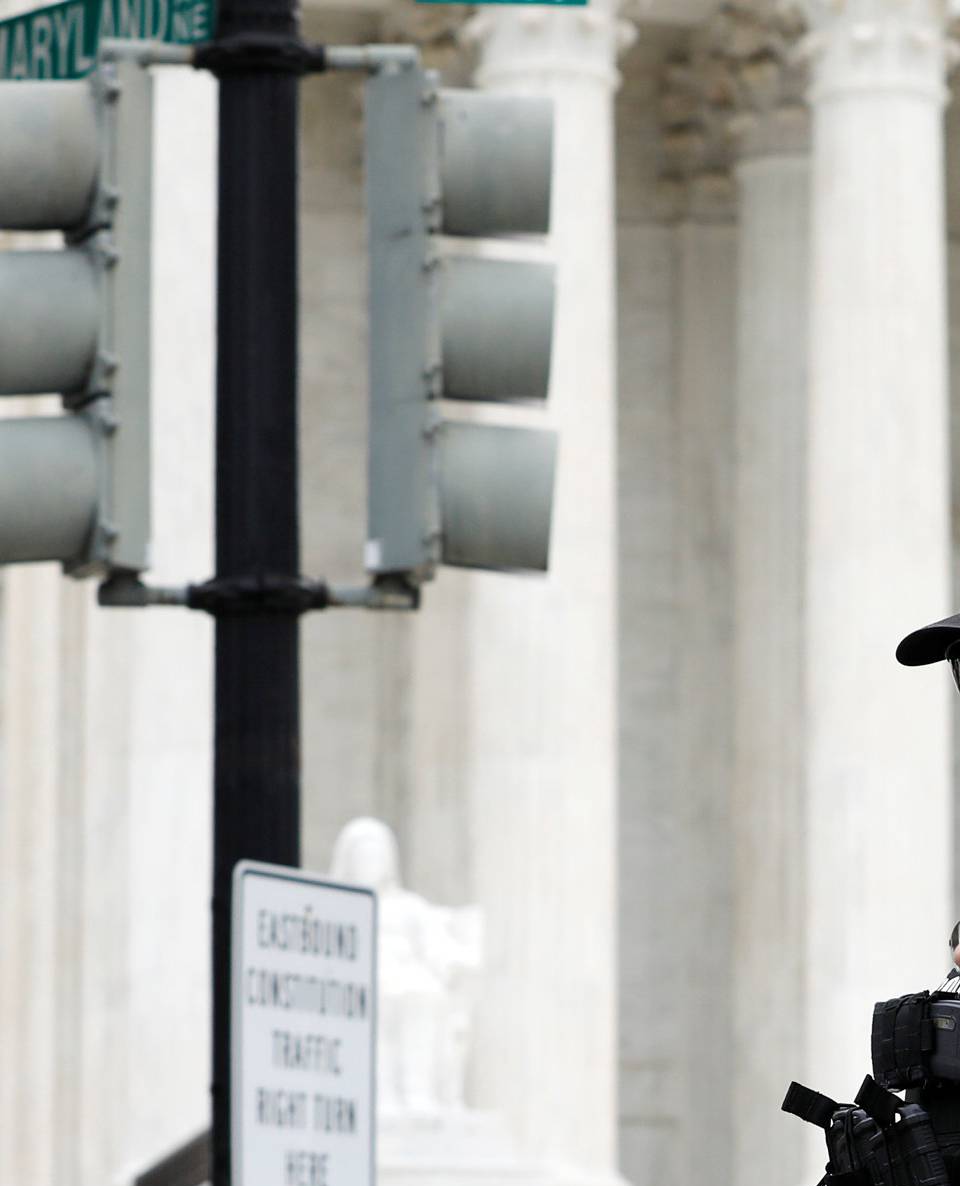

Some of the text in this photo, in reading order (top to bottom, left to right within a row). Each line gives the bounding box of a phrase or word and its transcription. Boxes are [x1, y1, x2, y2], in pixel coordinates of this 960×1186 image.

[271, 1029, 341, 1075] TRAFFIC
[256, 1086, 357, 1134] RIGHT TURN
